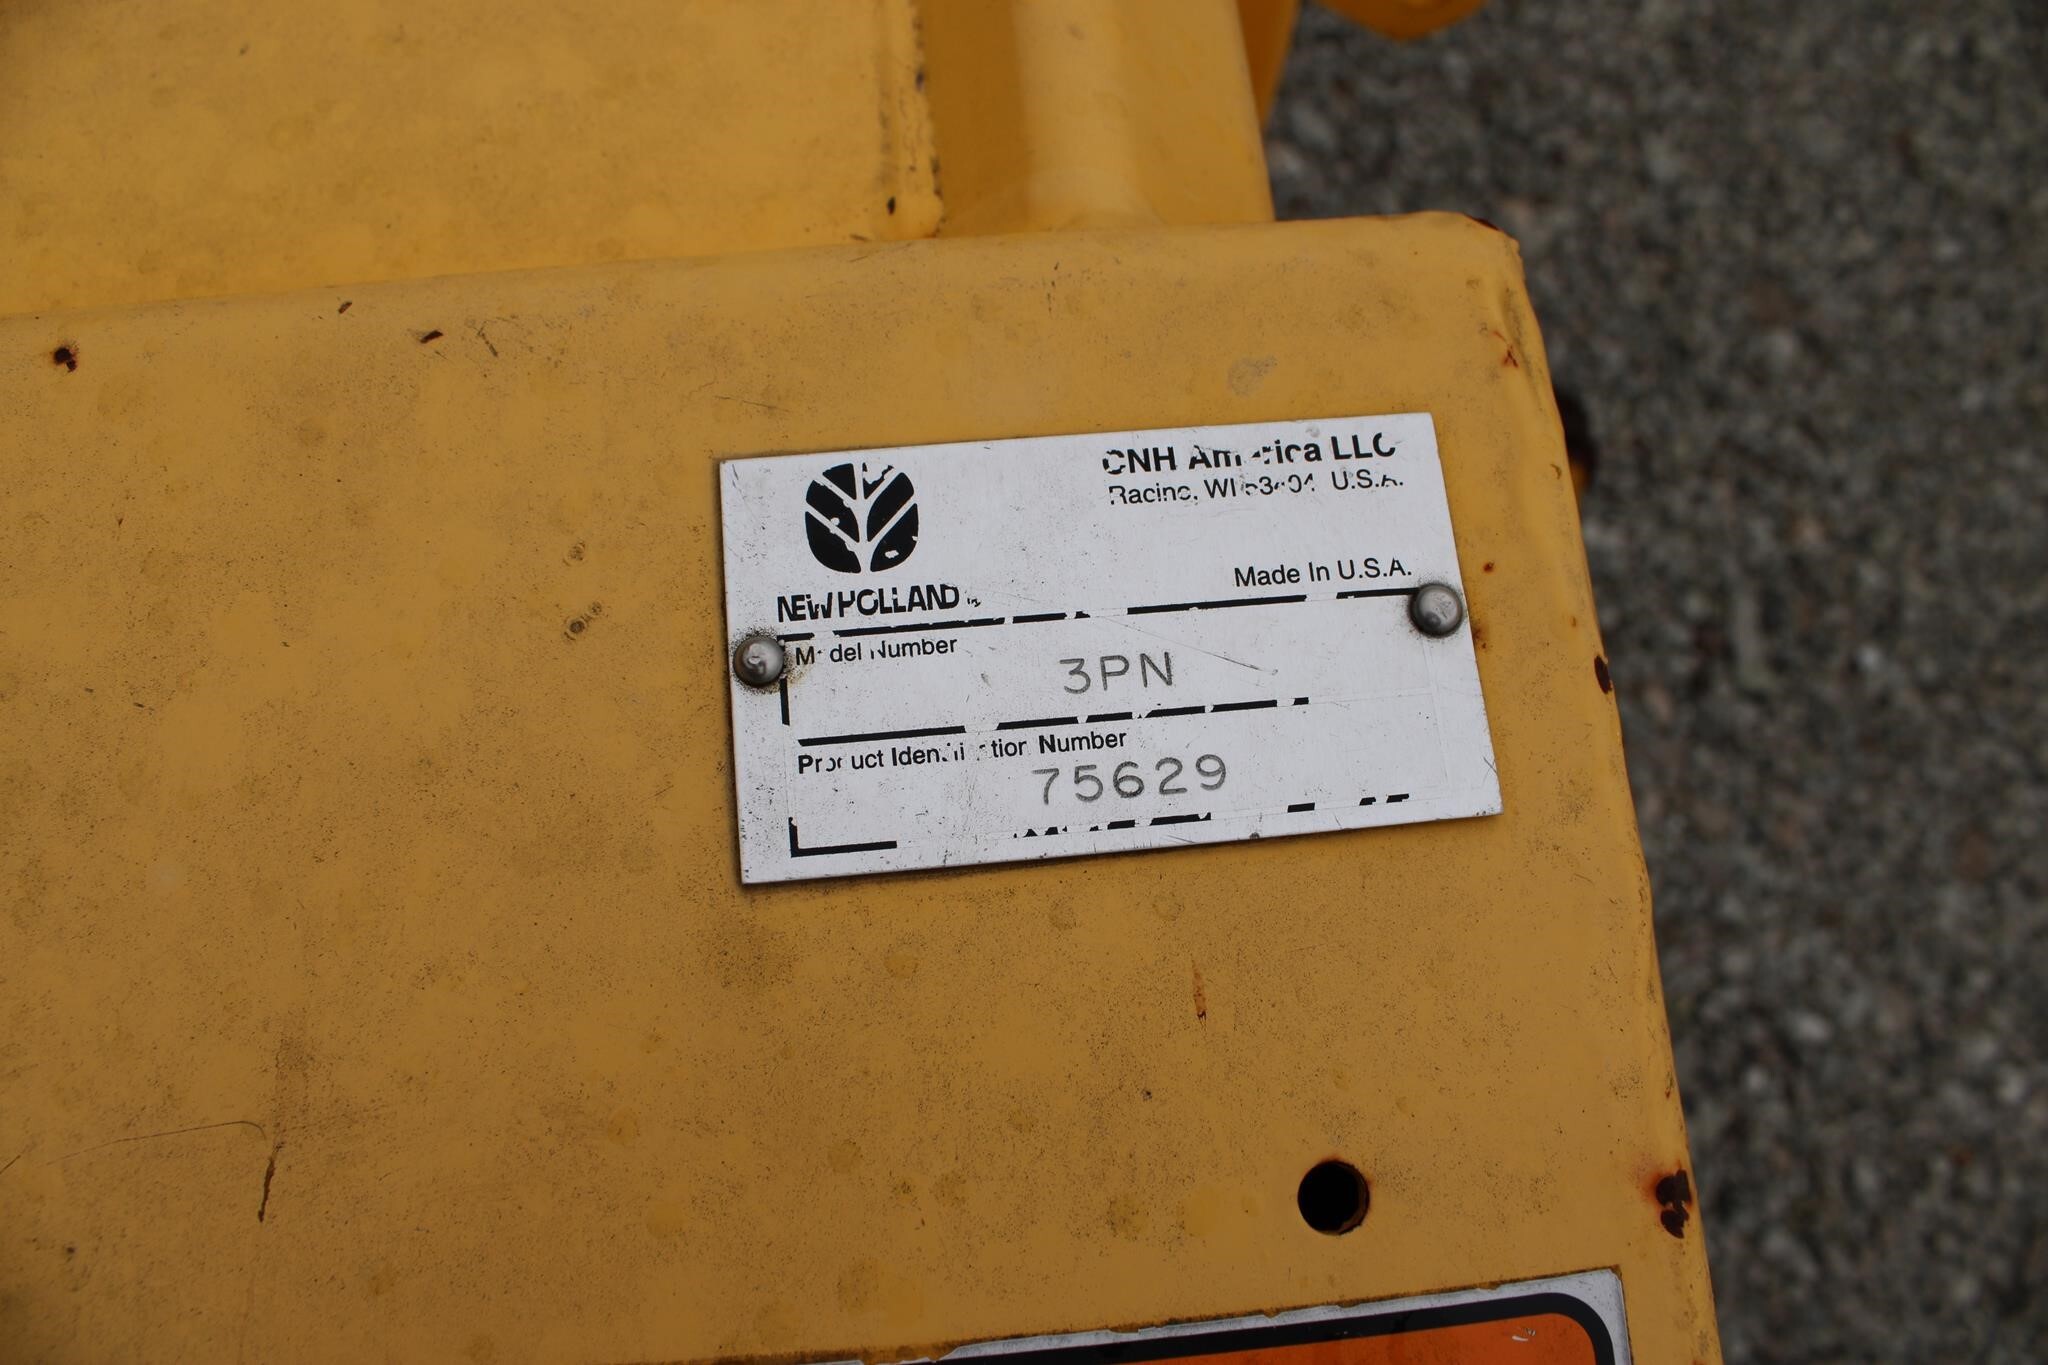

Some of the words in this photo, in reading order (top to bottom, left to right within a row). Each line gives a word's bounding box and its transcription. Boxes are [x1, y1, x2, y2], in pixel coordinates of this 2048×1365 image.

[1102, 446, 1176, 475] CNH
[1331, 432, 1396, 460] LLC
[1204, 478, 1236, 498] WI
[1234, 563, 1300, 587] Made
[1309, 561, 1330, 582] In
[1338, 557, 1412, 579] U.S.A.
[777, 592, 833, 623] NEW
[796, 642, 862, 665] Mdel
[1059, 651, 1173, 695] 3PN
[1039, 730, 1127, 754] Number
[1031, 753, 1227, 805] 75629
